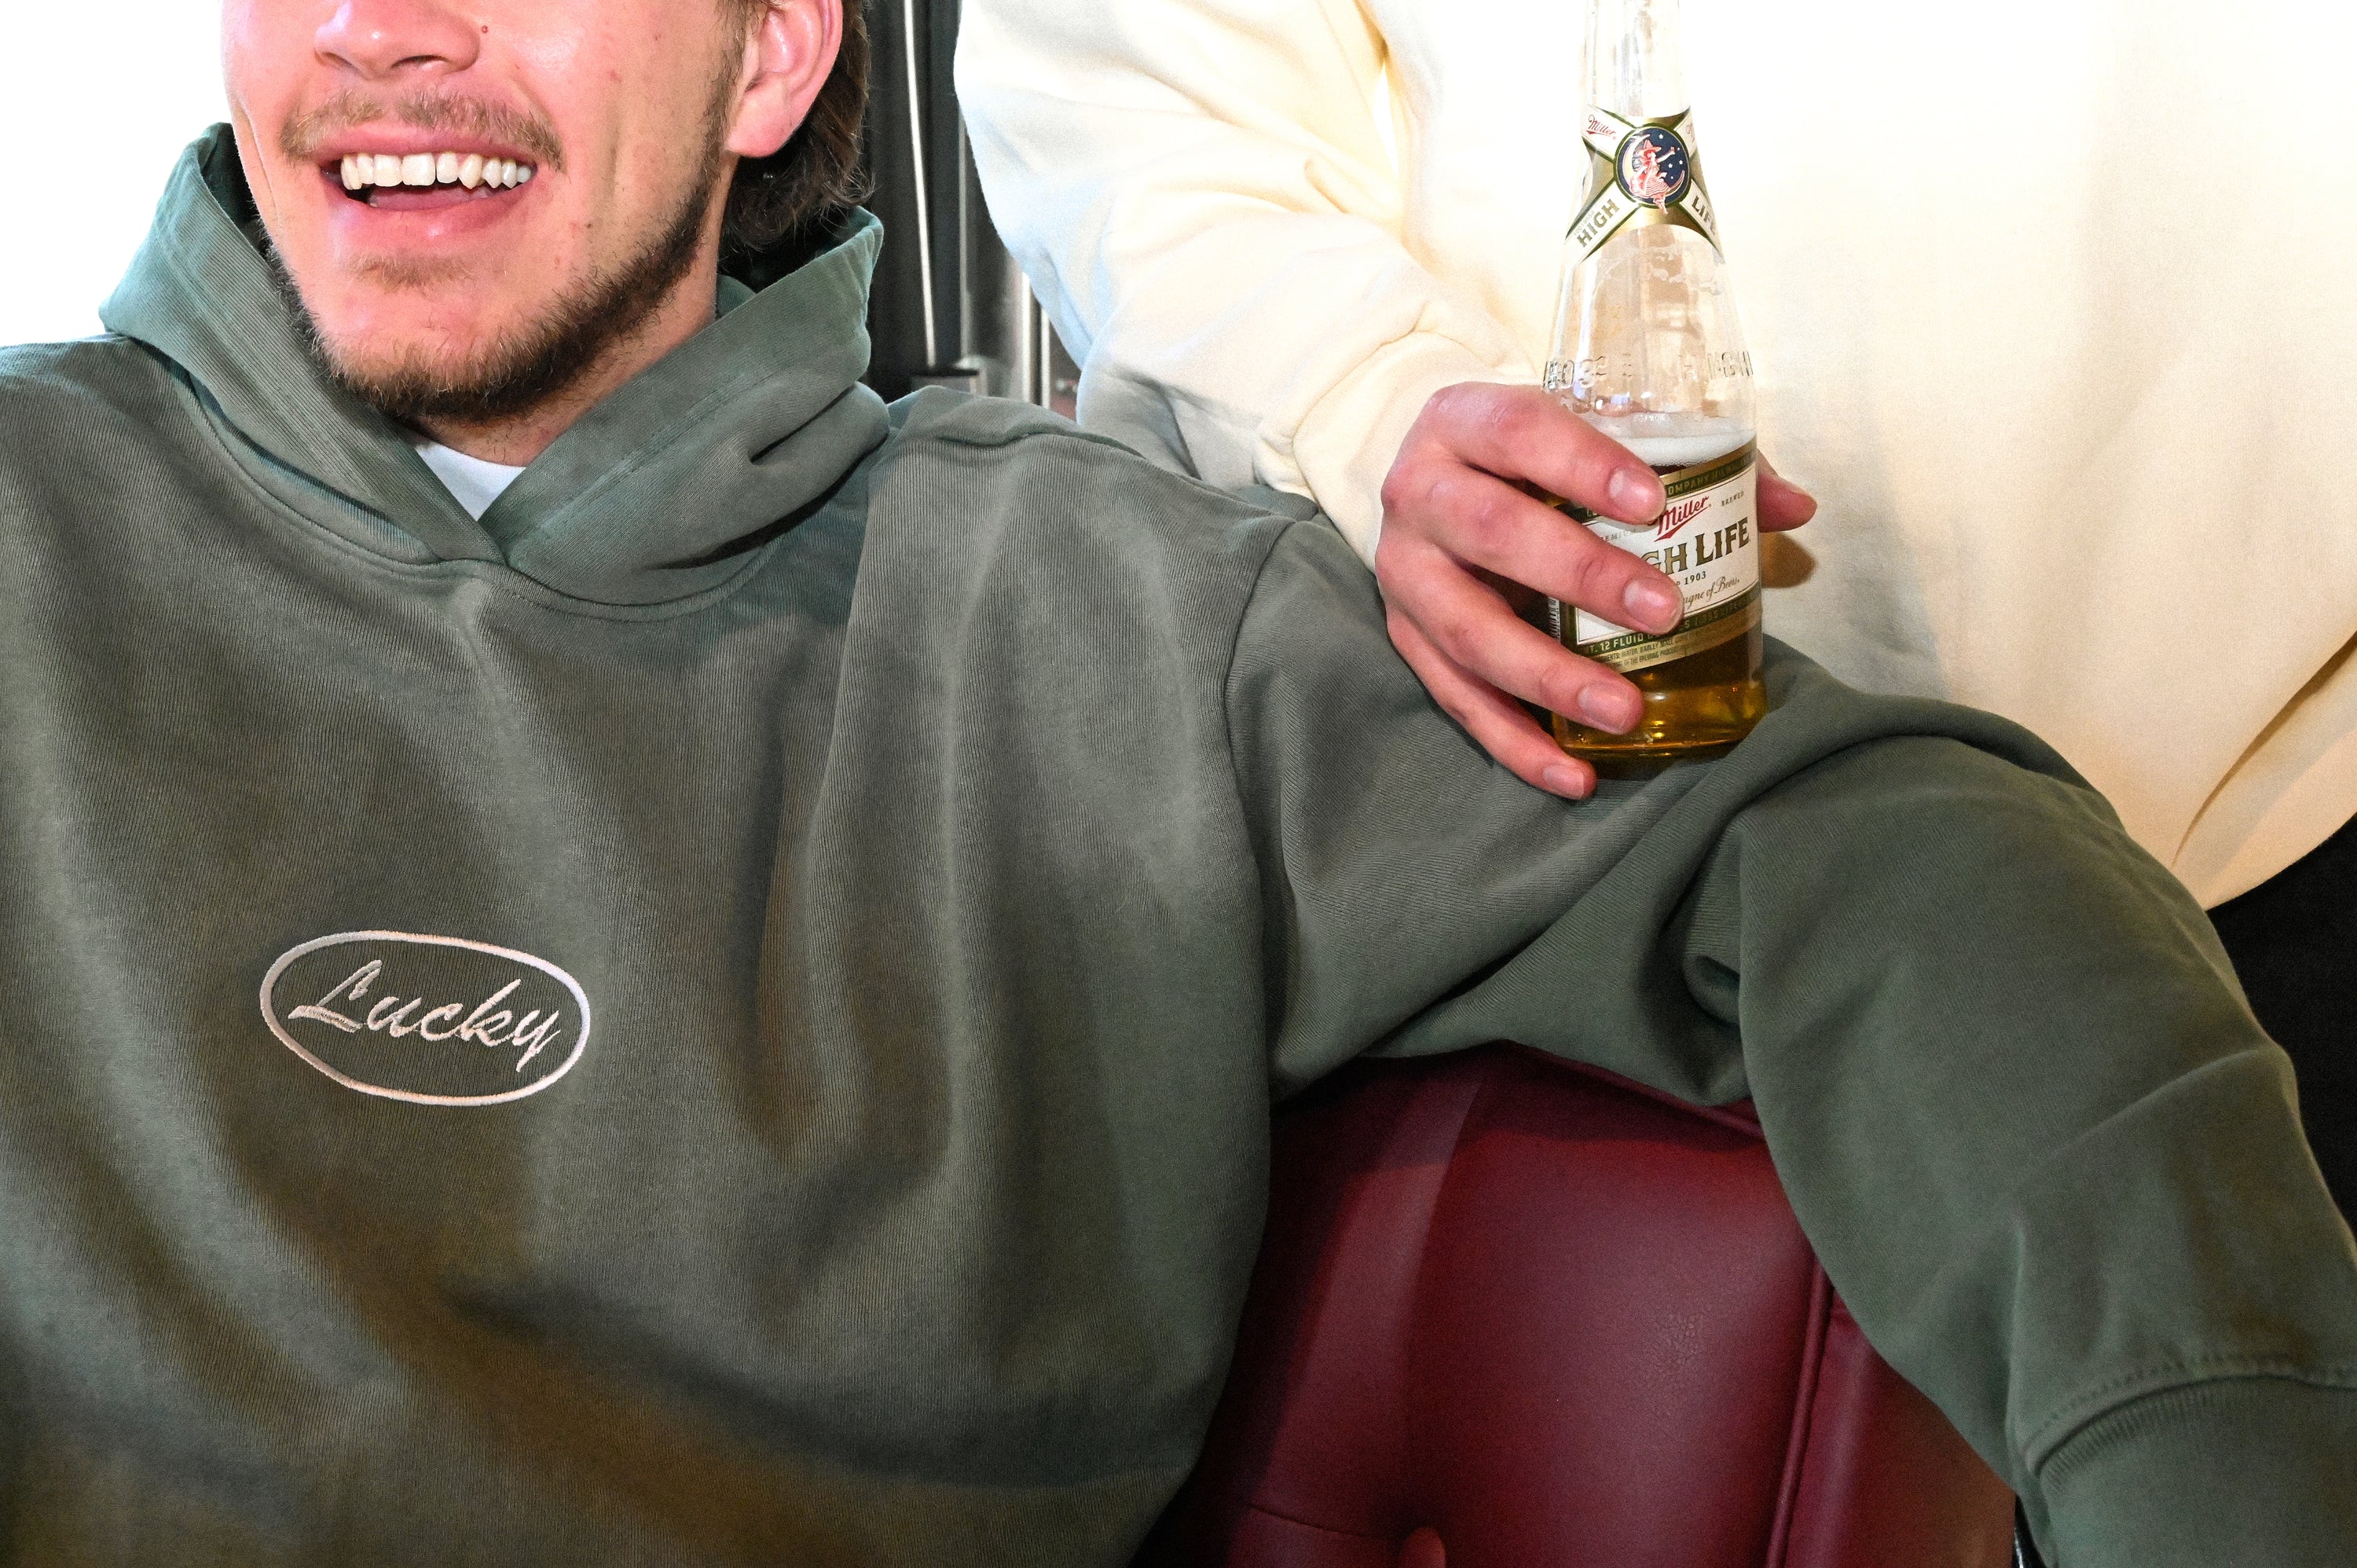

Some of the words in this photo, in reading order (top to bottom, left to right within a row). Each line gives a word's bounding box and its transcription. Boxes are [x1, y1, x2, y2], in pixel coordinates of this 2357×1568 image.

[1585, 115, 1615, 137] Miller
[1577, 199, 1619, 247] HIGH
[1667, 474, 1710, 496] OMPANY
[1721, 490, 1745, 507] BREWED
[1648, 496, 1710, 542] Miller
[1641, 542, 1688, 576] GH
[1695, 516, 1750, 566] LIFE
[1684, 570, 1706, 585] 1903
[1600, 640, 1611, 651] 12
[1613, 632, 1644, 648] FLUID
[288, 959, 560, 1072] Lucky
